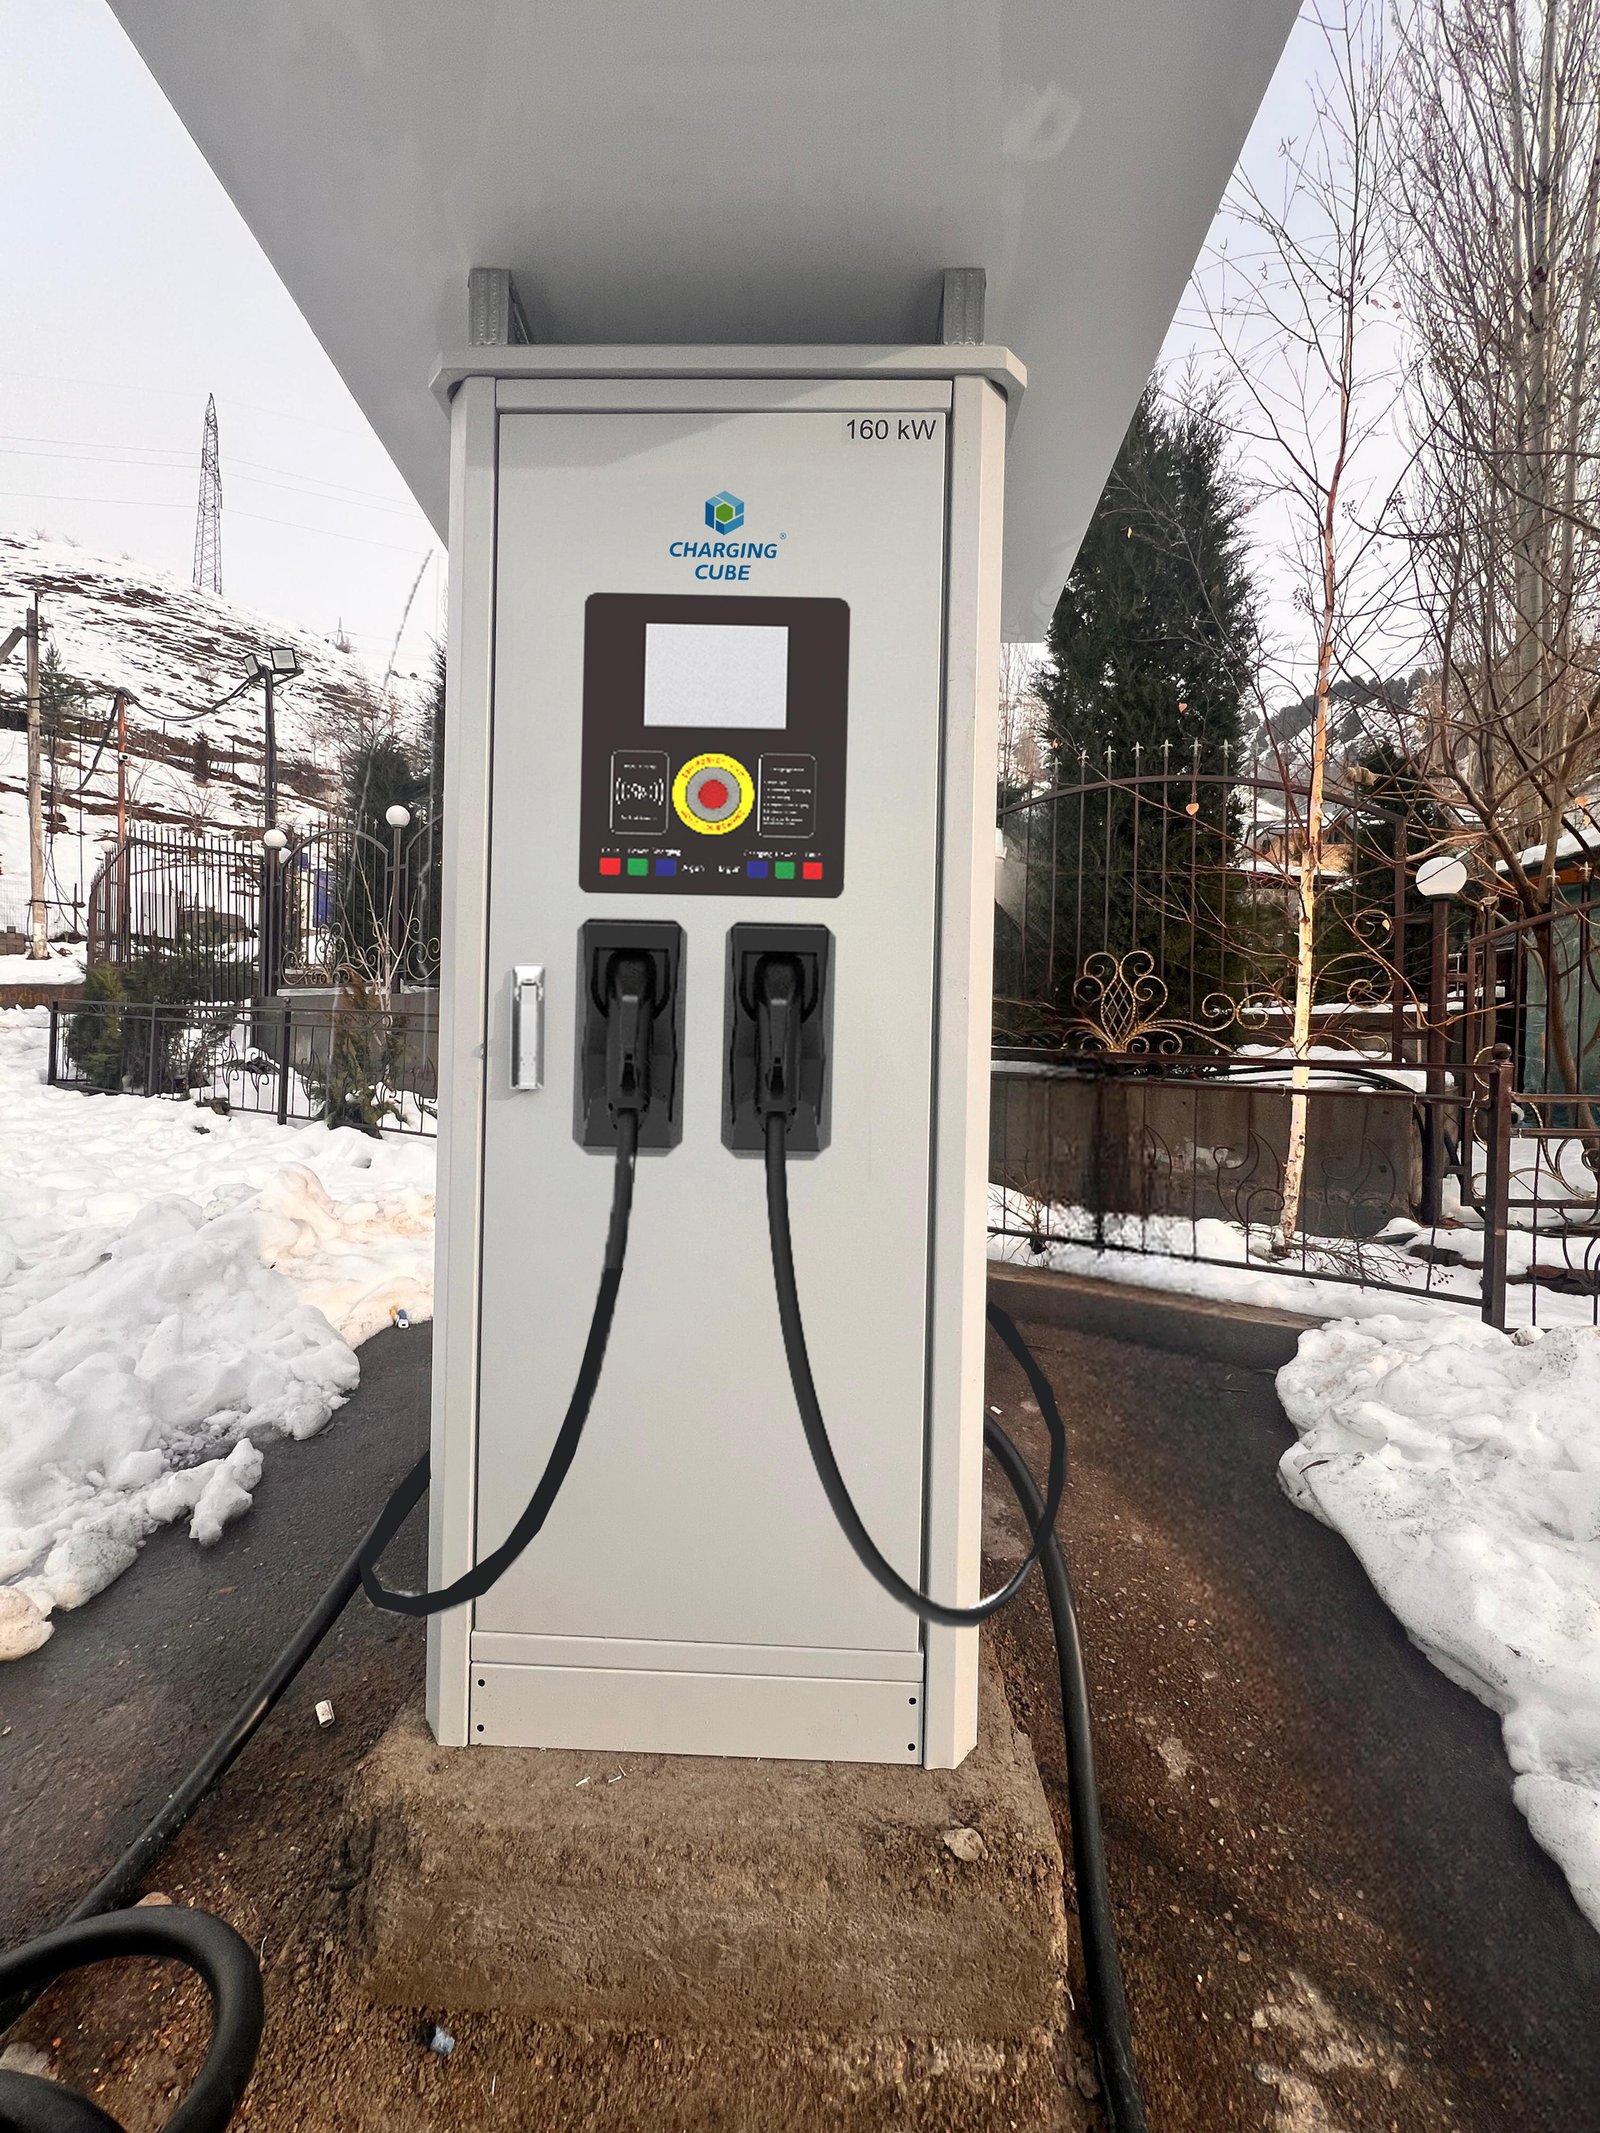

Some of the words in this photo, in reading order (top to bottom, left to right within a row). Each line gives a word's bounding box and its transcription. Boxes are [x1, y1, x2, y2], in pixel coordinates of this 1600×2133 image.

[847, 419, 889, 440] 160
[898, 419, 937, 440] kW
[669, 541, 777, 559] CHARGING
[695, 564, 751, 580] CUBE
